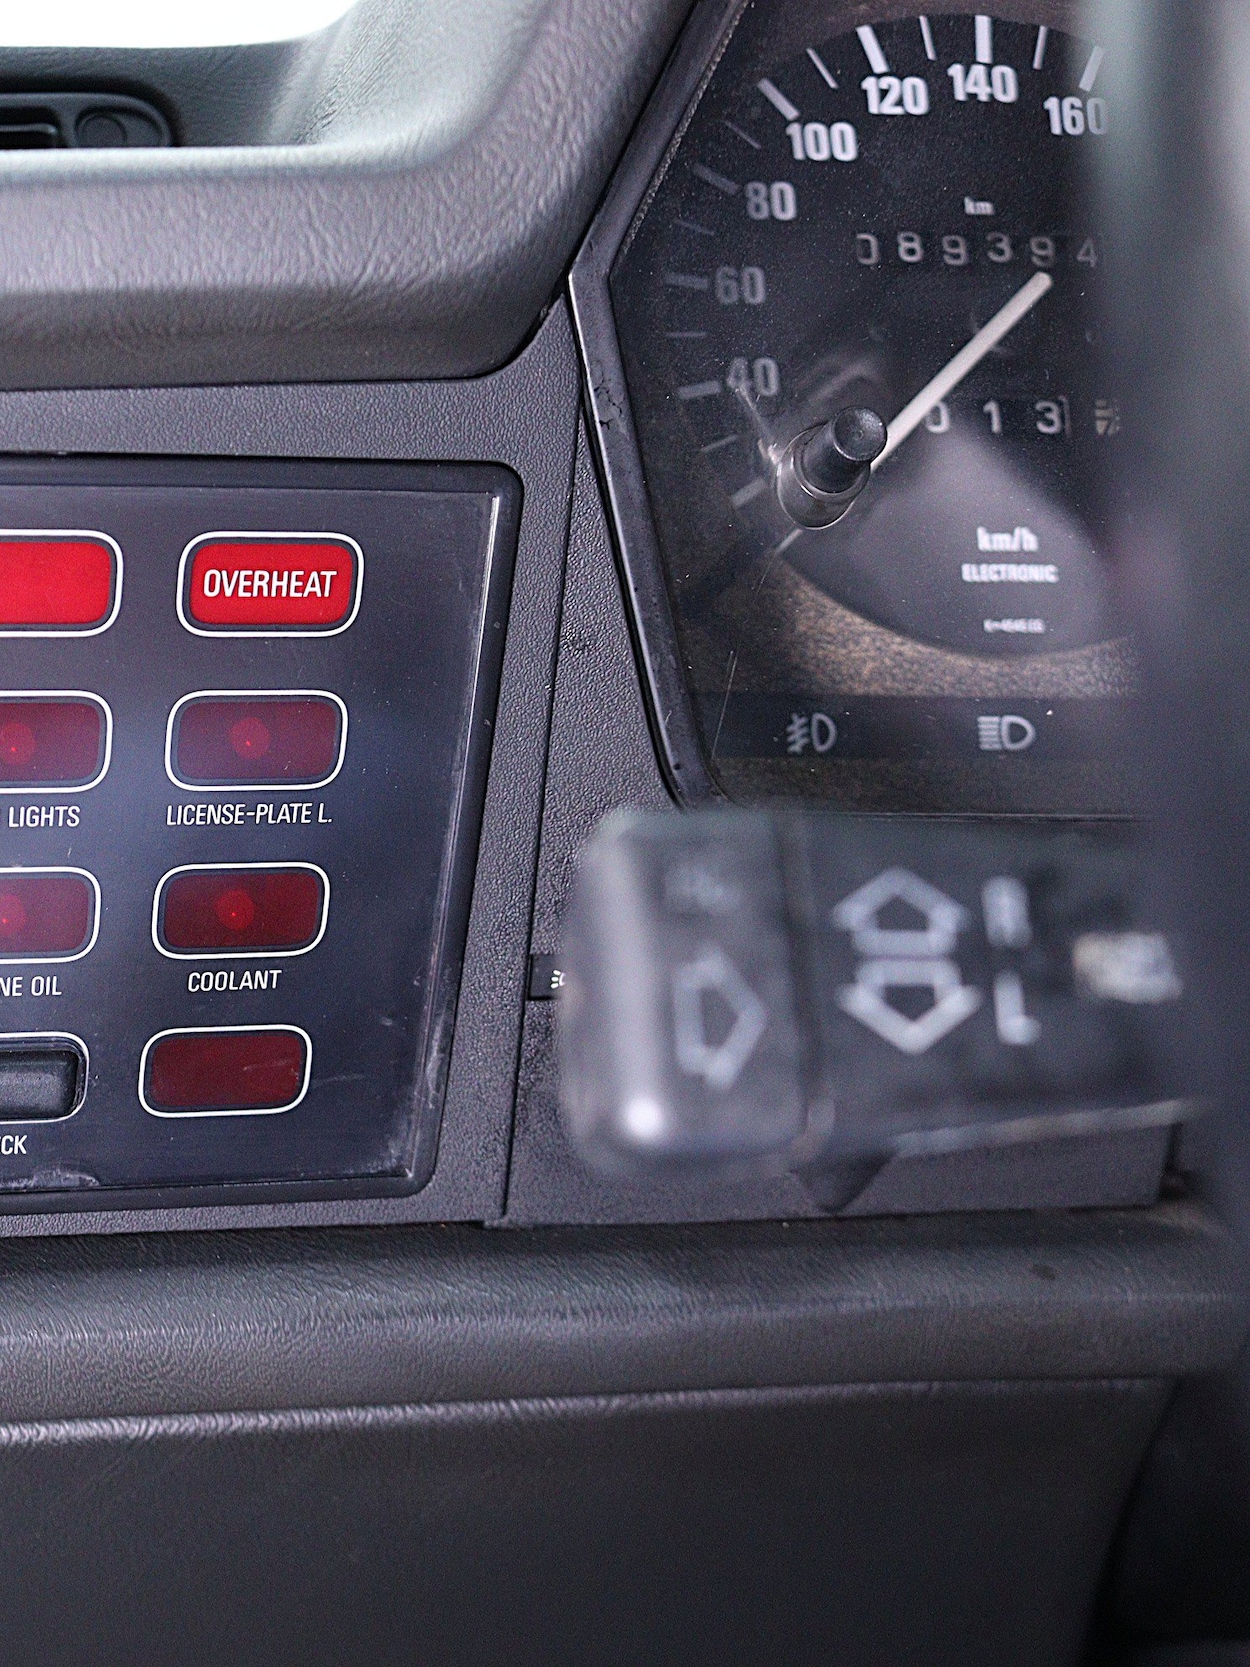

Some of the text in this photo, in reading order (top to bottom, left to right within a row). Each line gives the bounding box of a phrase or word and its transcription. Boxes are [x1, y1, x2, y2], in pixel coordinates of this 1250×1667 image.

[860, 75, 930, 116] 120
[947, 63, 1019, 103] 140
[1044, 96, 1109, 136] 160
[785, 121, 859, 162] 100
[744, 181, 797, 221] 80
[964, 197, 995, 216] km
[714, 266, 767, 305] 60
[726, 356, 780, 397] 40
[976, 526, 1039, 552] km/h
[203, 569, 337, 598] OVERHEAT
[961, 563, 1060, 583] ELECTRONIC
[9, 805, 81, 828] LIGHTS
[166, 802, 312, 826] LICENSE-PLATE
[31, 975, 62, 996] OIL
[187, 969, 282, 992] COOLANT
